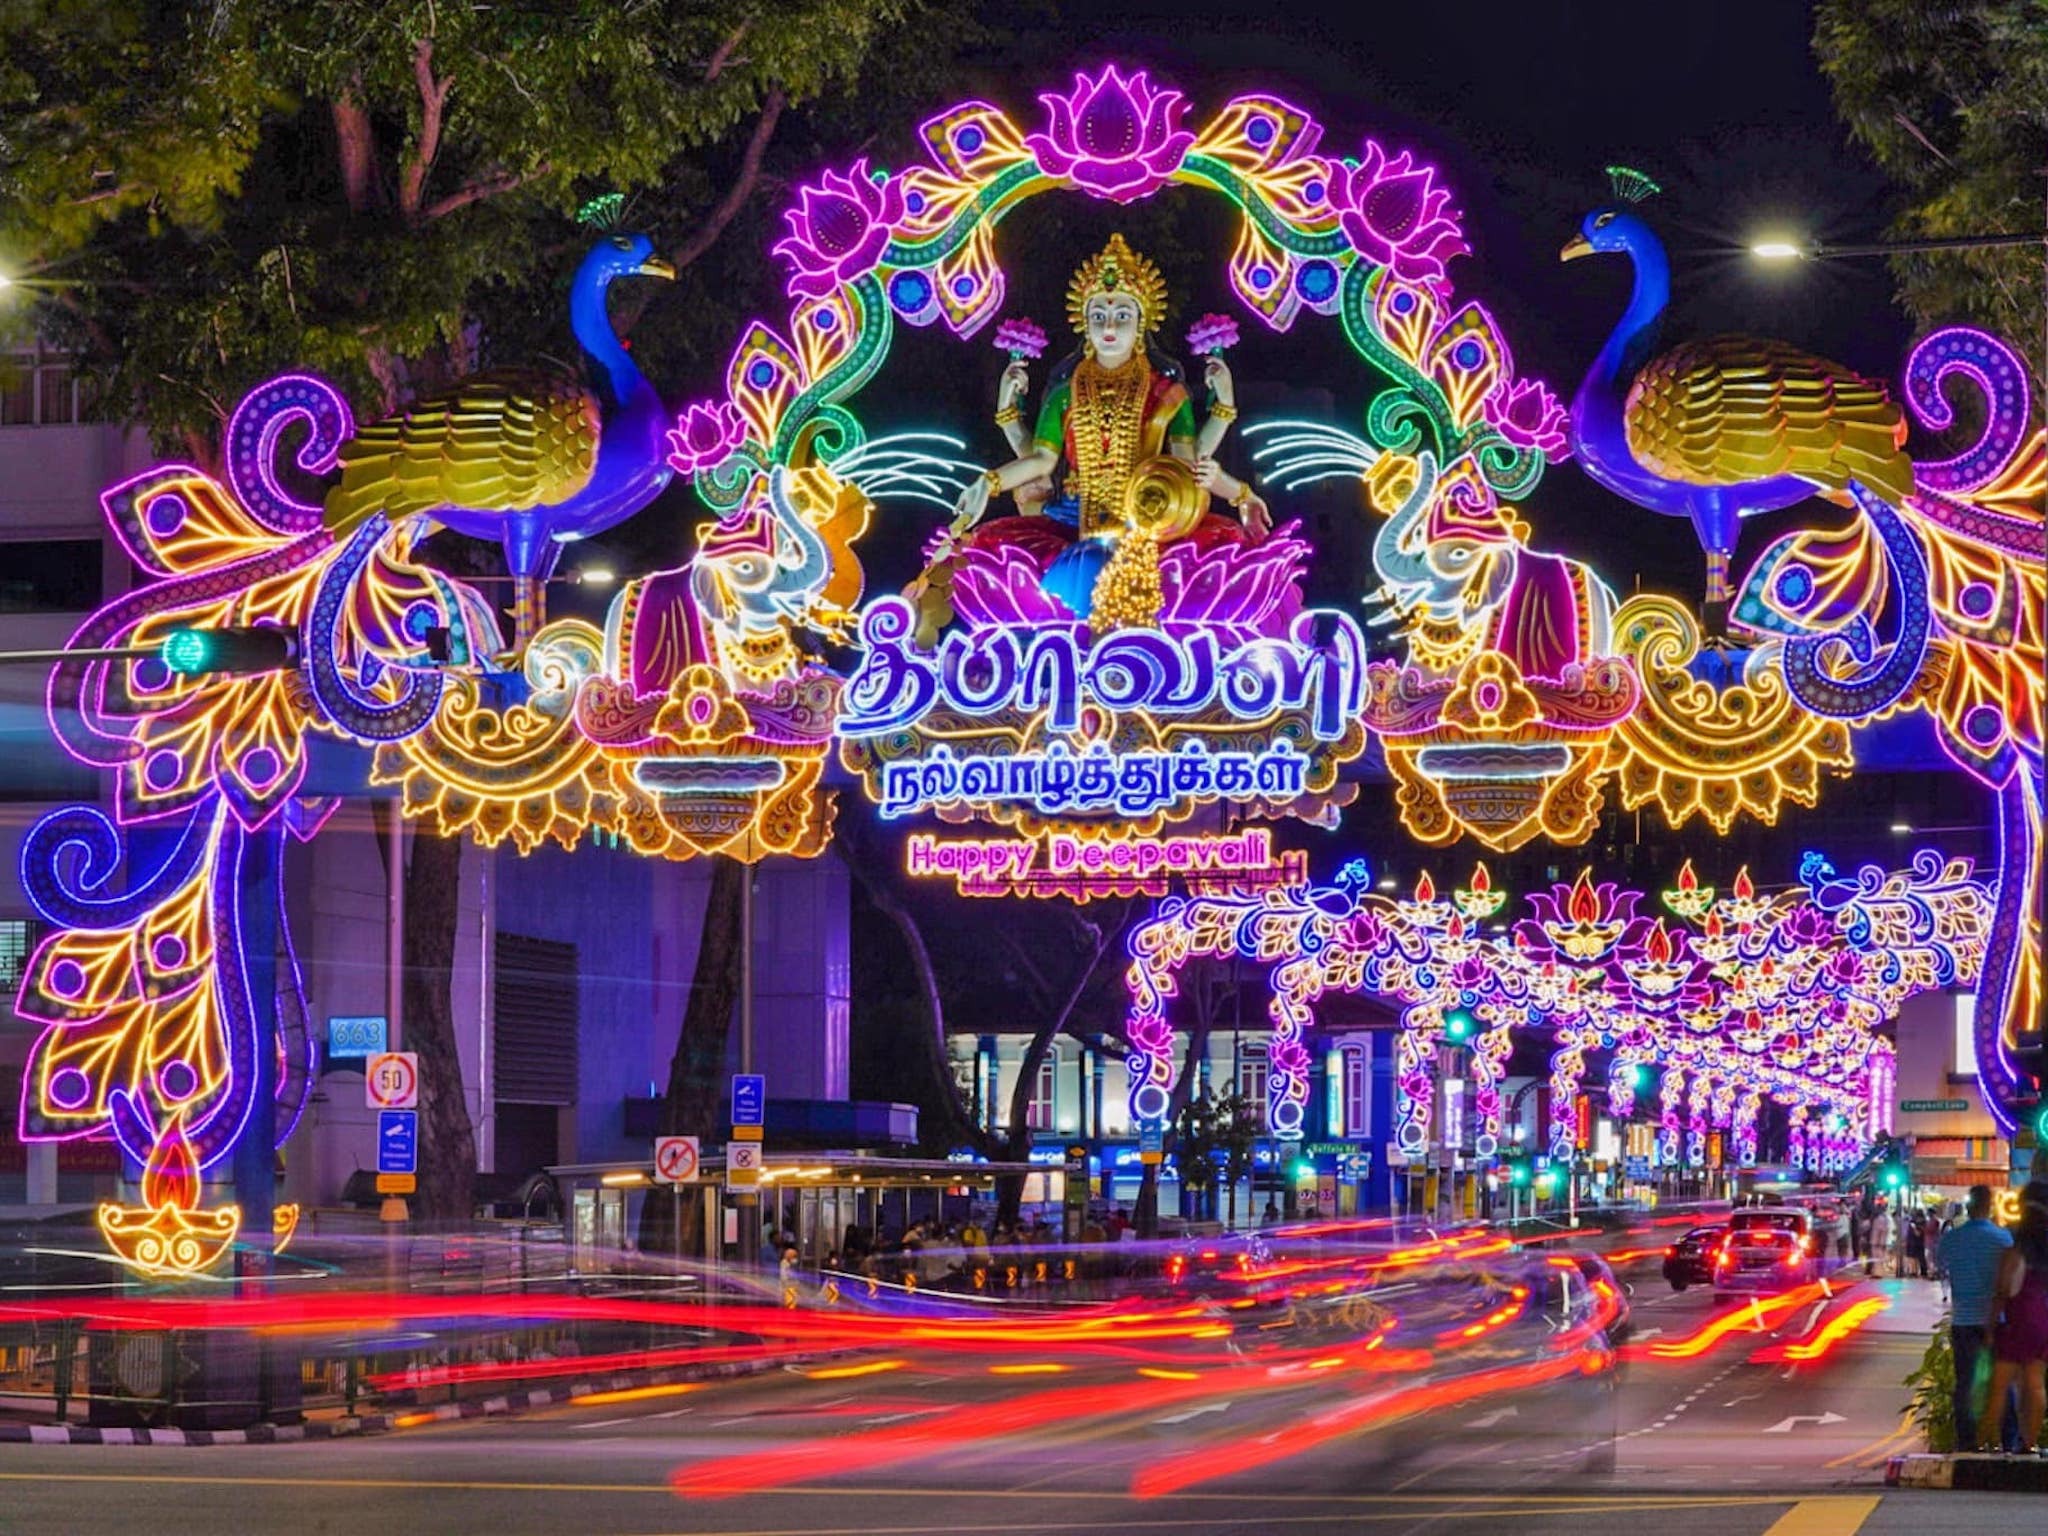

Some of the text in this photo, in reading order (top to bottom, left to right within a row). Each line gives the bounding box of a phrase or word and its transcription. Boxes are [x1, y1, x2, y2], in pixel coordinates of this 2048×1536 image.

[834, 595, 1366, 740] தீபாவளி
[880, 738, 1309, 819] நல்வாழ்த்துக்கள்
[908, 835, 1038, 881] Happy
[335, 1022, 381, 1046] 663
[381, 1070, 402, 1090] 50
